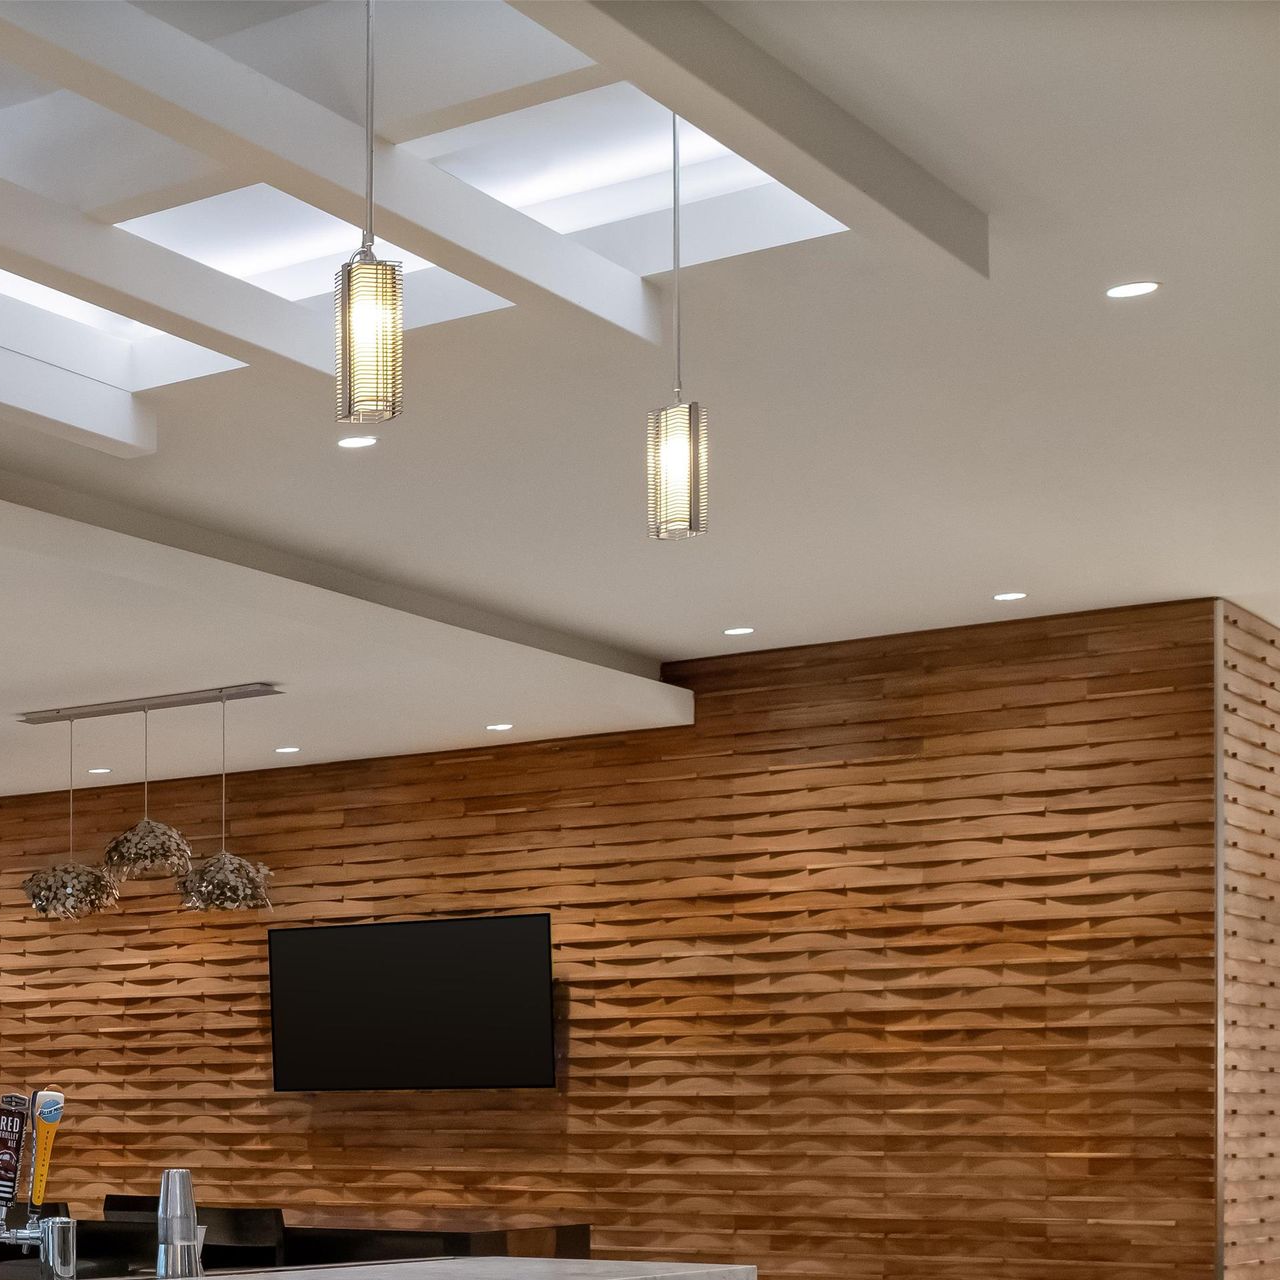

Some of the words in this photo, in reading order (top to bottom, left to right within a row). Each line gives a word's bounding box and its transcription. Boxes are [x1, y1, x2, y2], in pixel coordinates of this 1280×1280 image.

[0, 1115, 20, 1133] RED
[0, 1131, 19, 1140] TROLLEY
[7, 1140, 17, 1148] ALE
